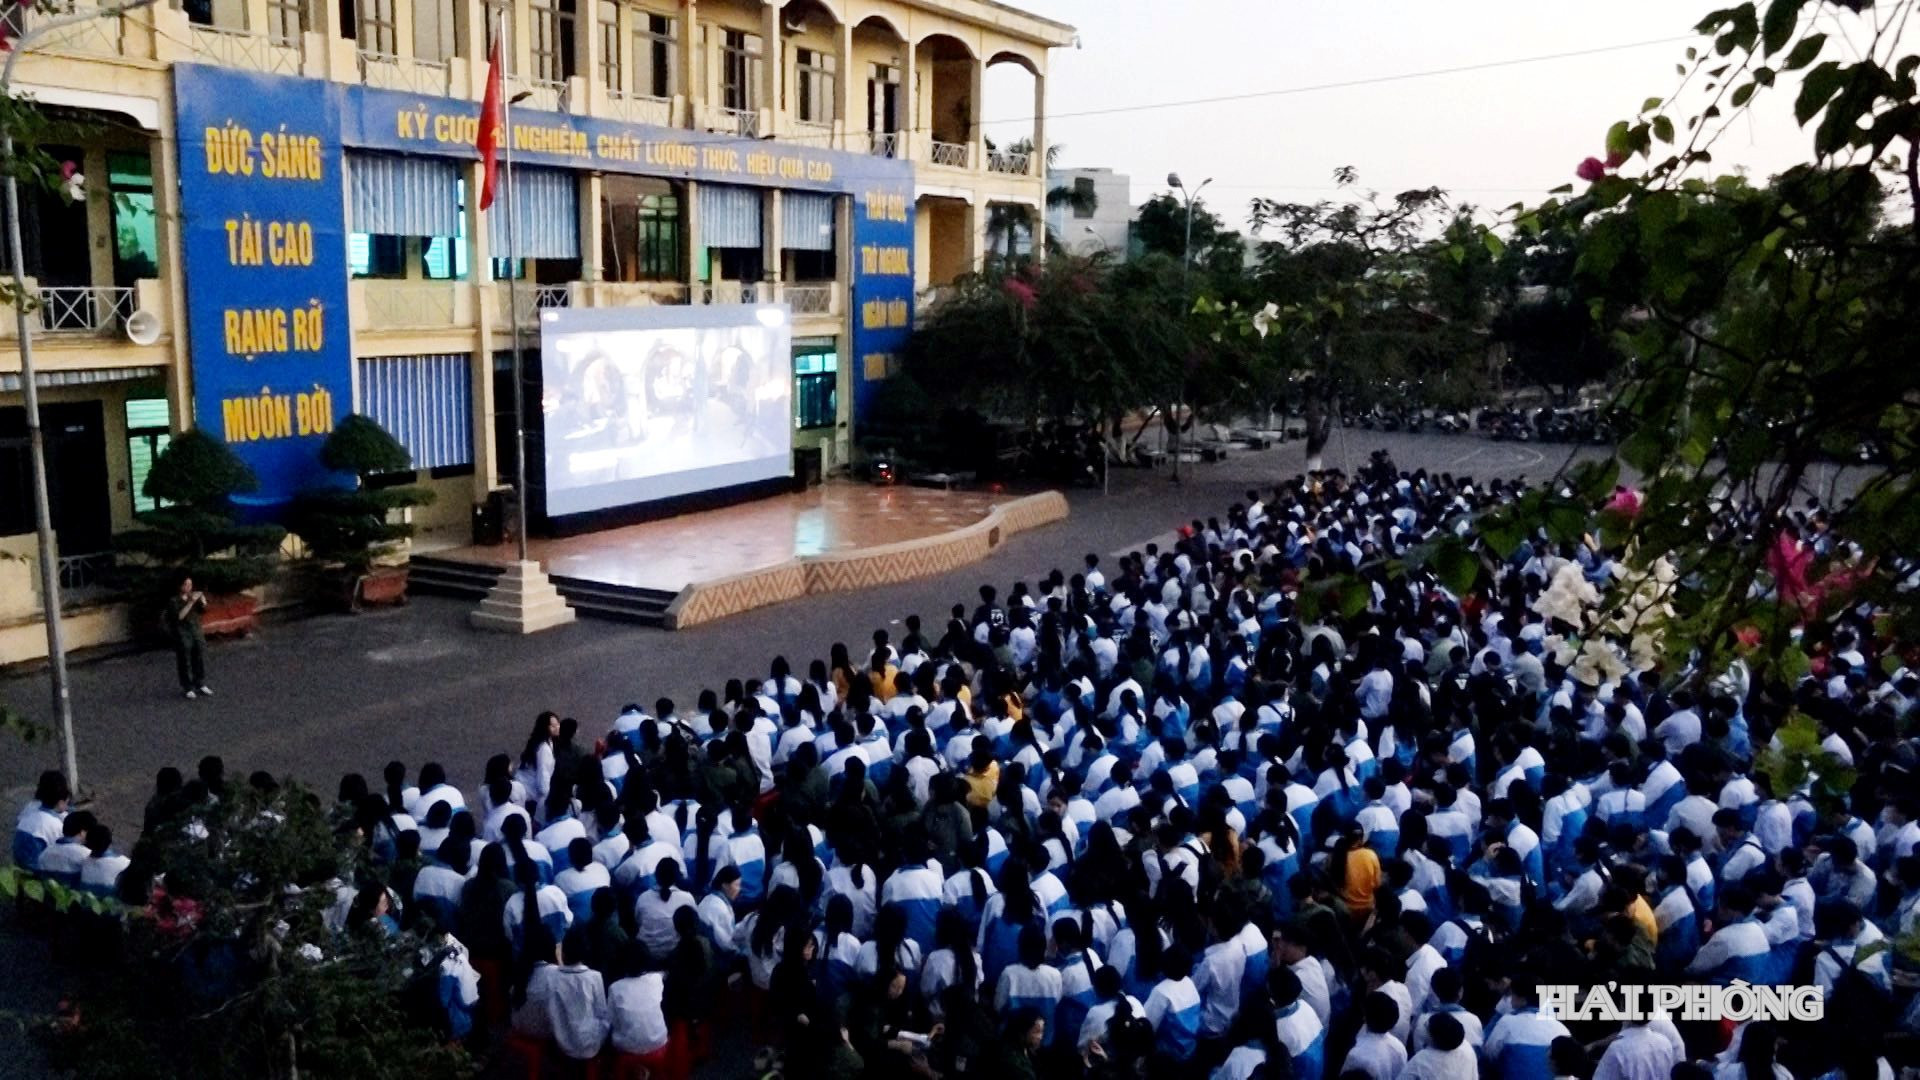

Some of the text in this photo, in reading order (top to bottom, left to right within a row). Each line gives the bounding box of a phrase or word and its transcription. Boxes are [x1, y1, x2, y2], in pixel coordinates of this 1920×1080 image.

[205, 118, 321, 180] ĐỨC SÁNG
[434, 113, 506, 149] CƯƠG
[646, 140, 698, 171] LƯỢNG
[807, 160, 832, 182] CAO
[225, 211, 313, 266] TÀI CAO
[224, 297, 323, 360] RẠNG RỠ
[222, 383, 333, 442] MUÔN ĐỜI
